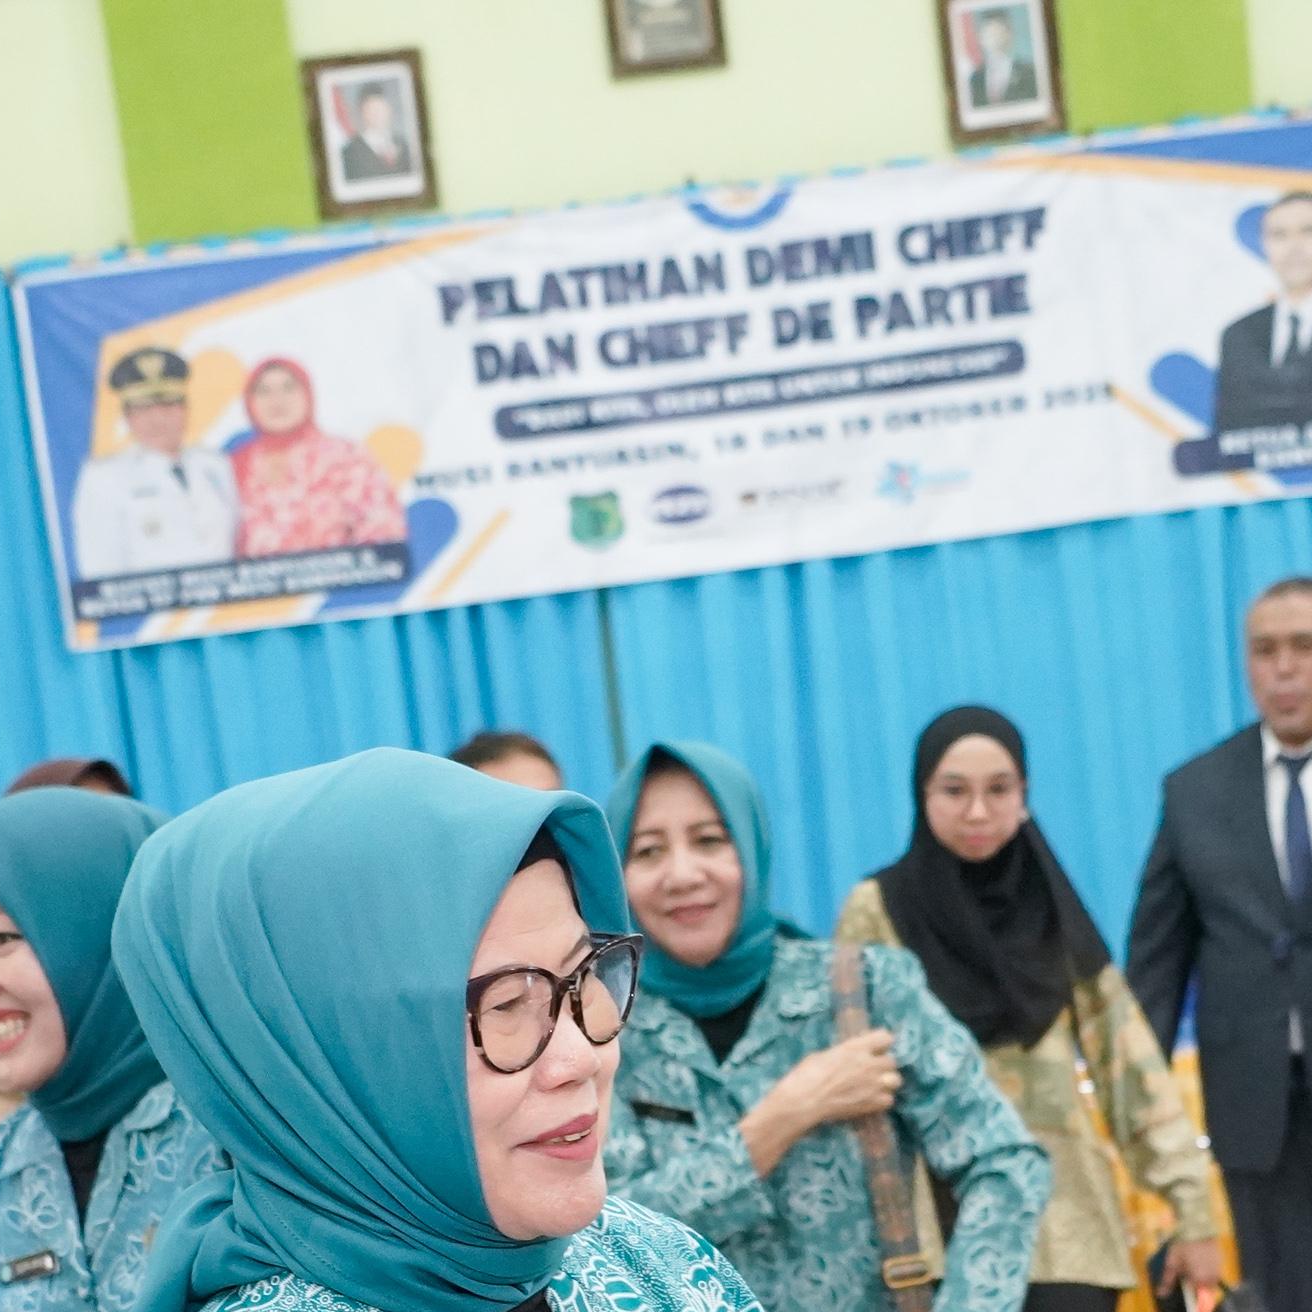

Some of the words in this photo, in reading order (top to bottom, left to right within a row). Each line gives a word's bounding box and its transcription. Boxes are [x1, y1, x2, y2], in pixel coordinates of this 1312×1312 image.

[438, 252, 727, 324] PELATIHAN
[747, 230, 877, 287] DEMI
[899, 206, 1046, 265] CHEFF
[474, 332, 578, 385] DAN
[599, 312, 749, 368] CHEFF
[772, 300, 835, 347] DE
[854, 274, 1031, 339] PARTIE
